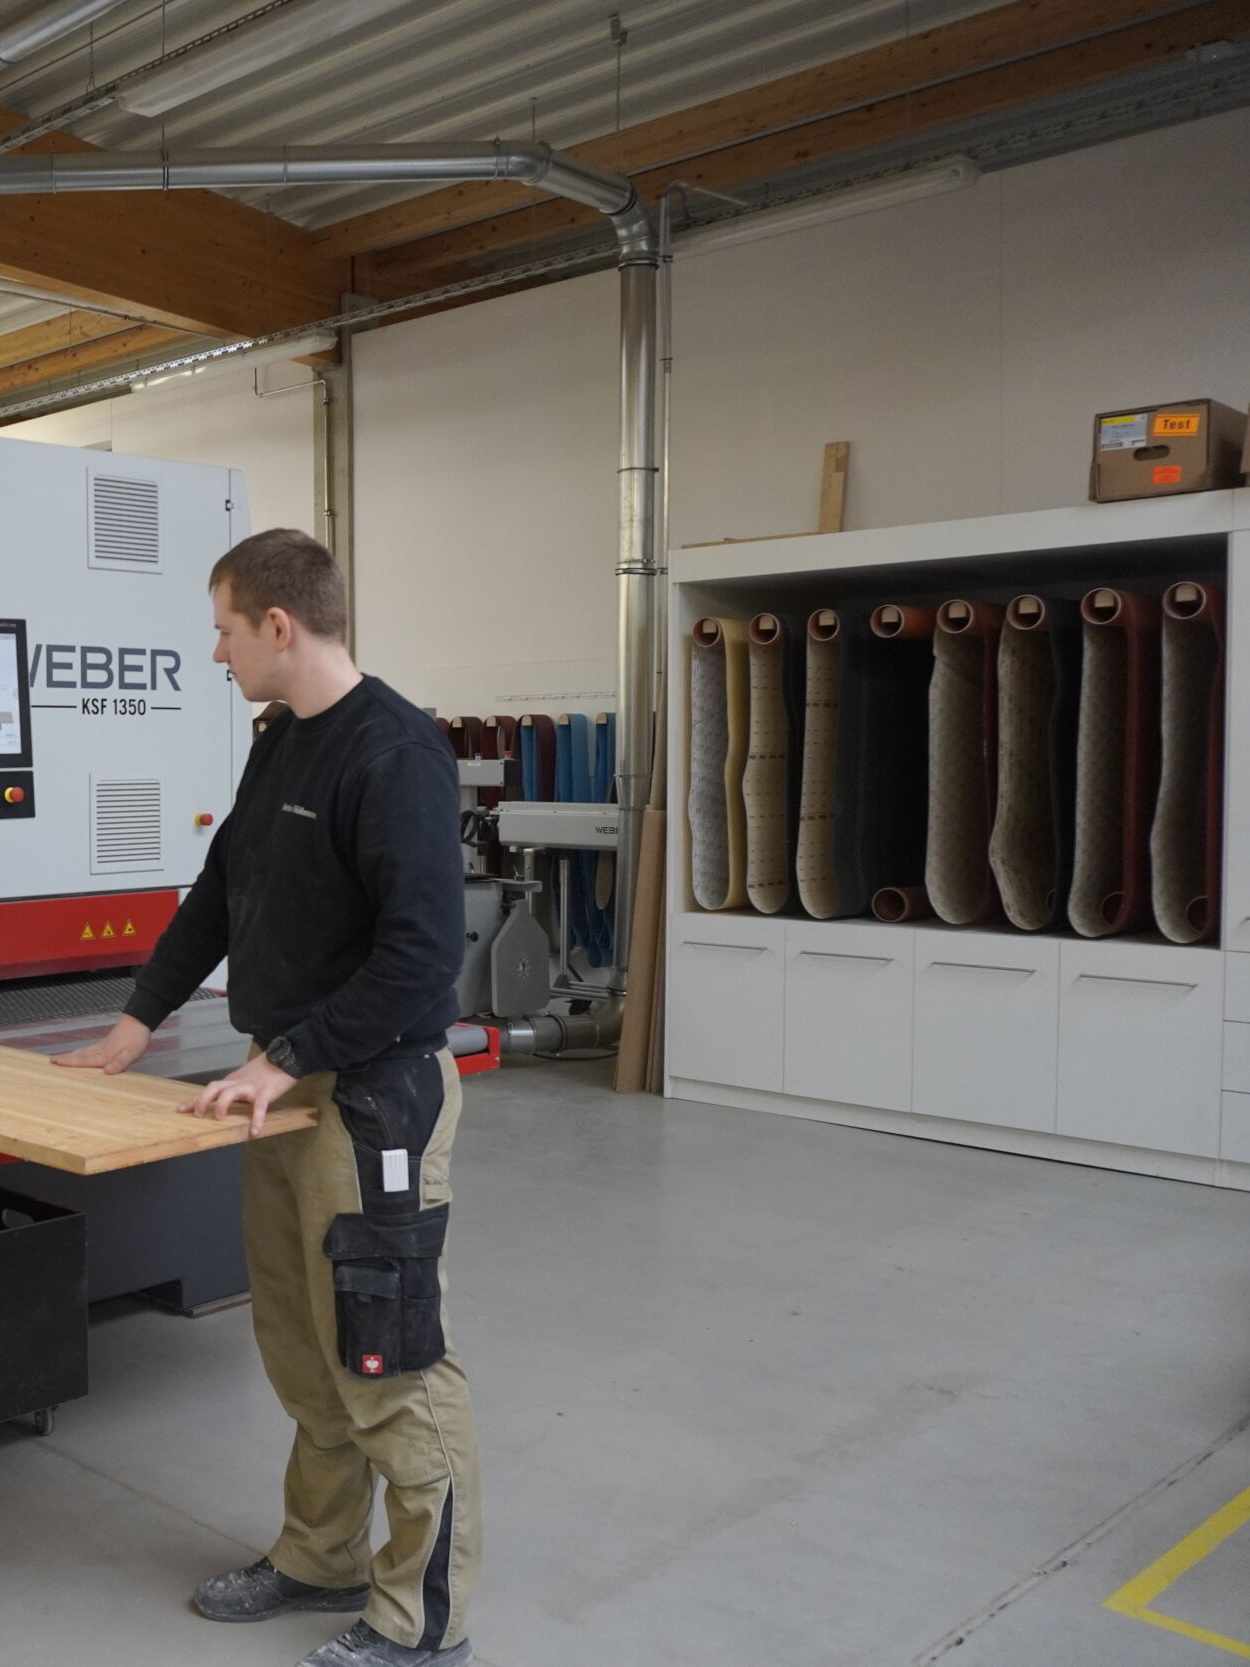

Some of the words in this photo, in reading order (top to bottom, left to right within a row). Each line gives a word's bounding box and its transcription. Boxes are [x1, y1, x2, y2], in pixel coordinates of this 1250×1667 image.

[1163, 419, 1191, 430] Test
[81, 697, 108, 716] KSF
[112, 698, 146, 716] 1350
